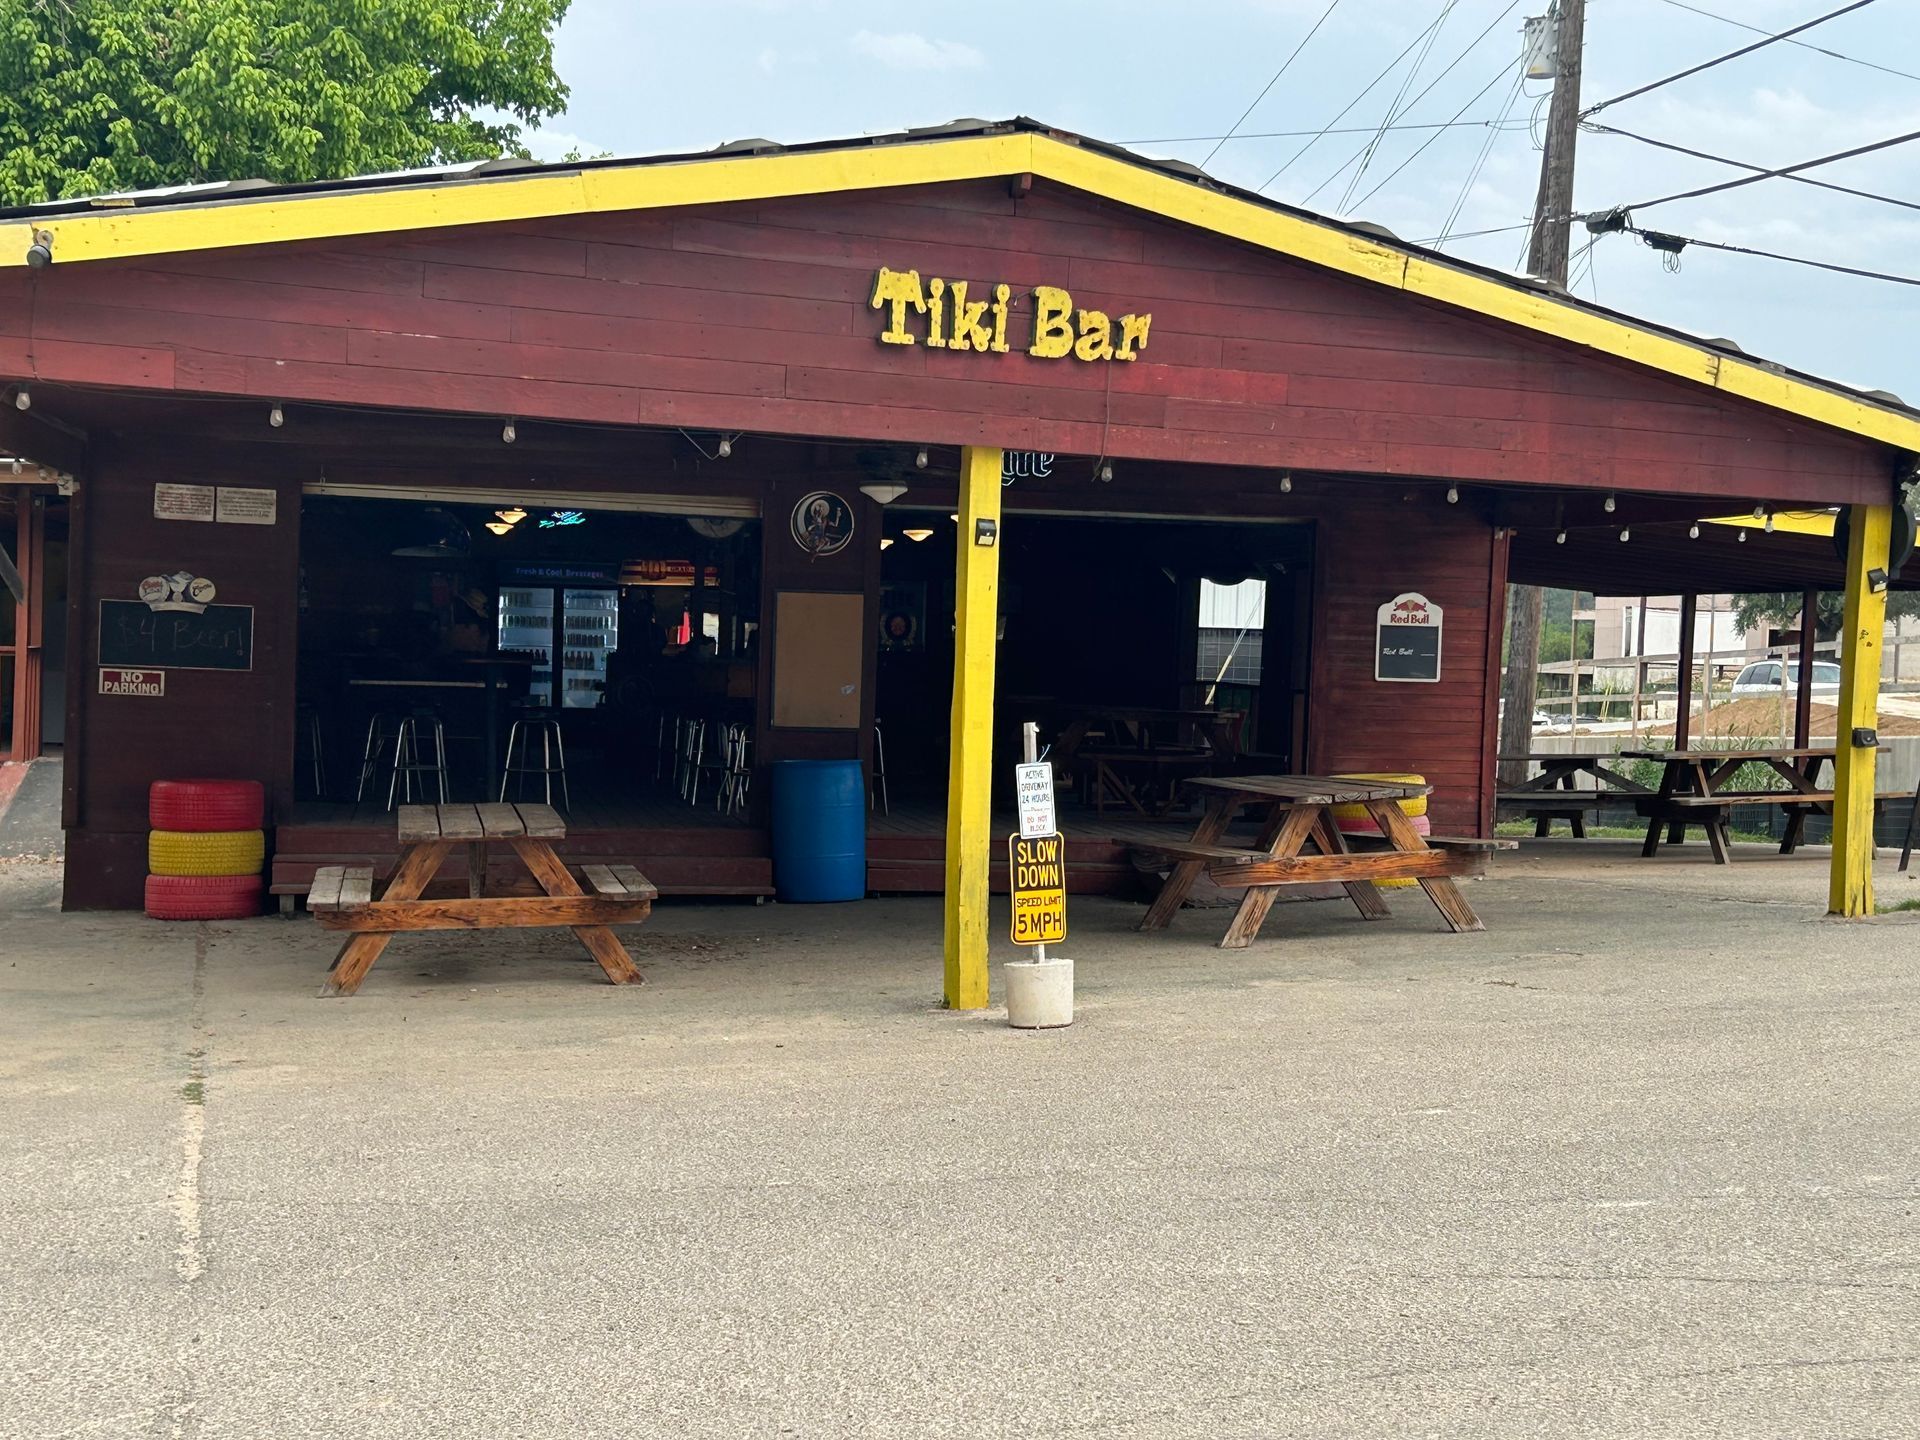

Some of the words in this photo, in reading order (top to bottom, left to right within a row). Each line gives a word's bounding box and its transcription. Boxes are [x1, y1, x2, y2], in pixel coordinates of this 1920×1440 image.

[872, 266, 1010, 353] Tiki
[1029, 285, 1152, 361] Bar
[1390, 613, 1410, 624] Red
[1410, 614, 1430, 624] Bull
[1382, 647, 1397, 656] Red
[120, 671, 143, 683] NO
[104, 681, 160, 694] PARKING
[1021, 795, 1030, 804] 24
[1031, 793, 1050, 803] HOURS
[1017, 840, 1058, 864] SLOW
[1018, 864, 1059, 888] DOWN
[1016, 897, 1042, 908] SPEED
[1043, 895, 1062, 906] LIMIT
[1017, 913, 1028, 934] 5
[1030, 911, 1062, 934] MPH
